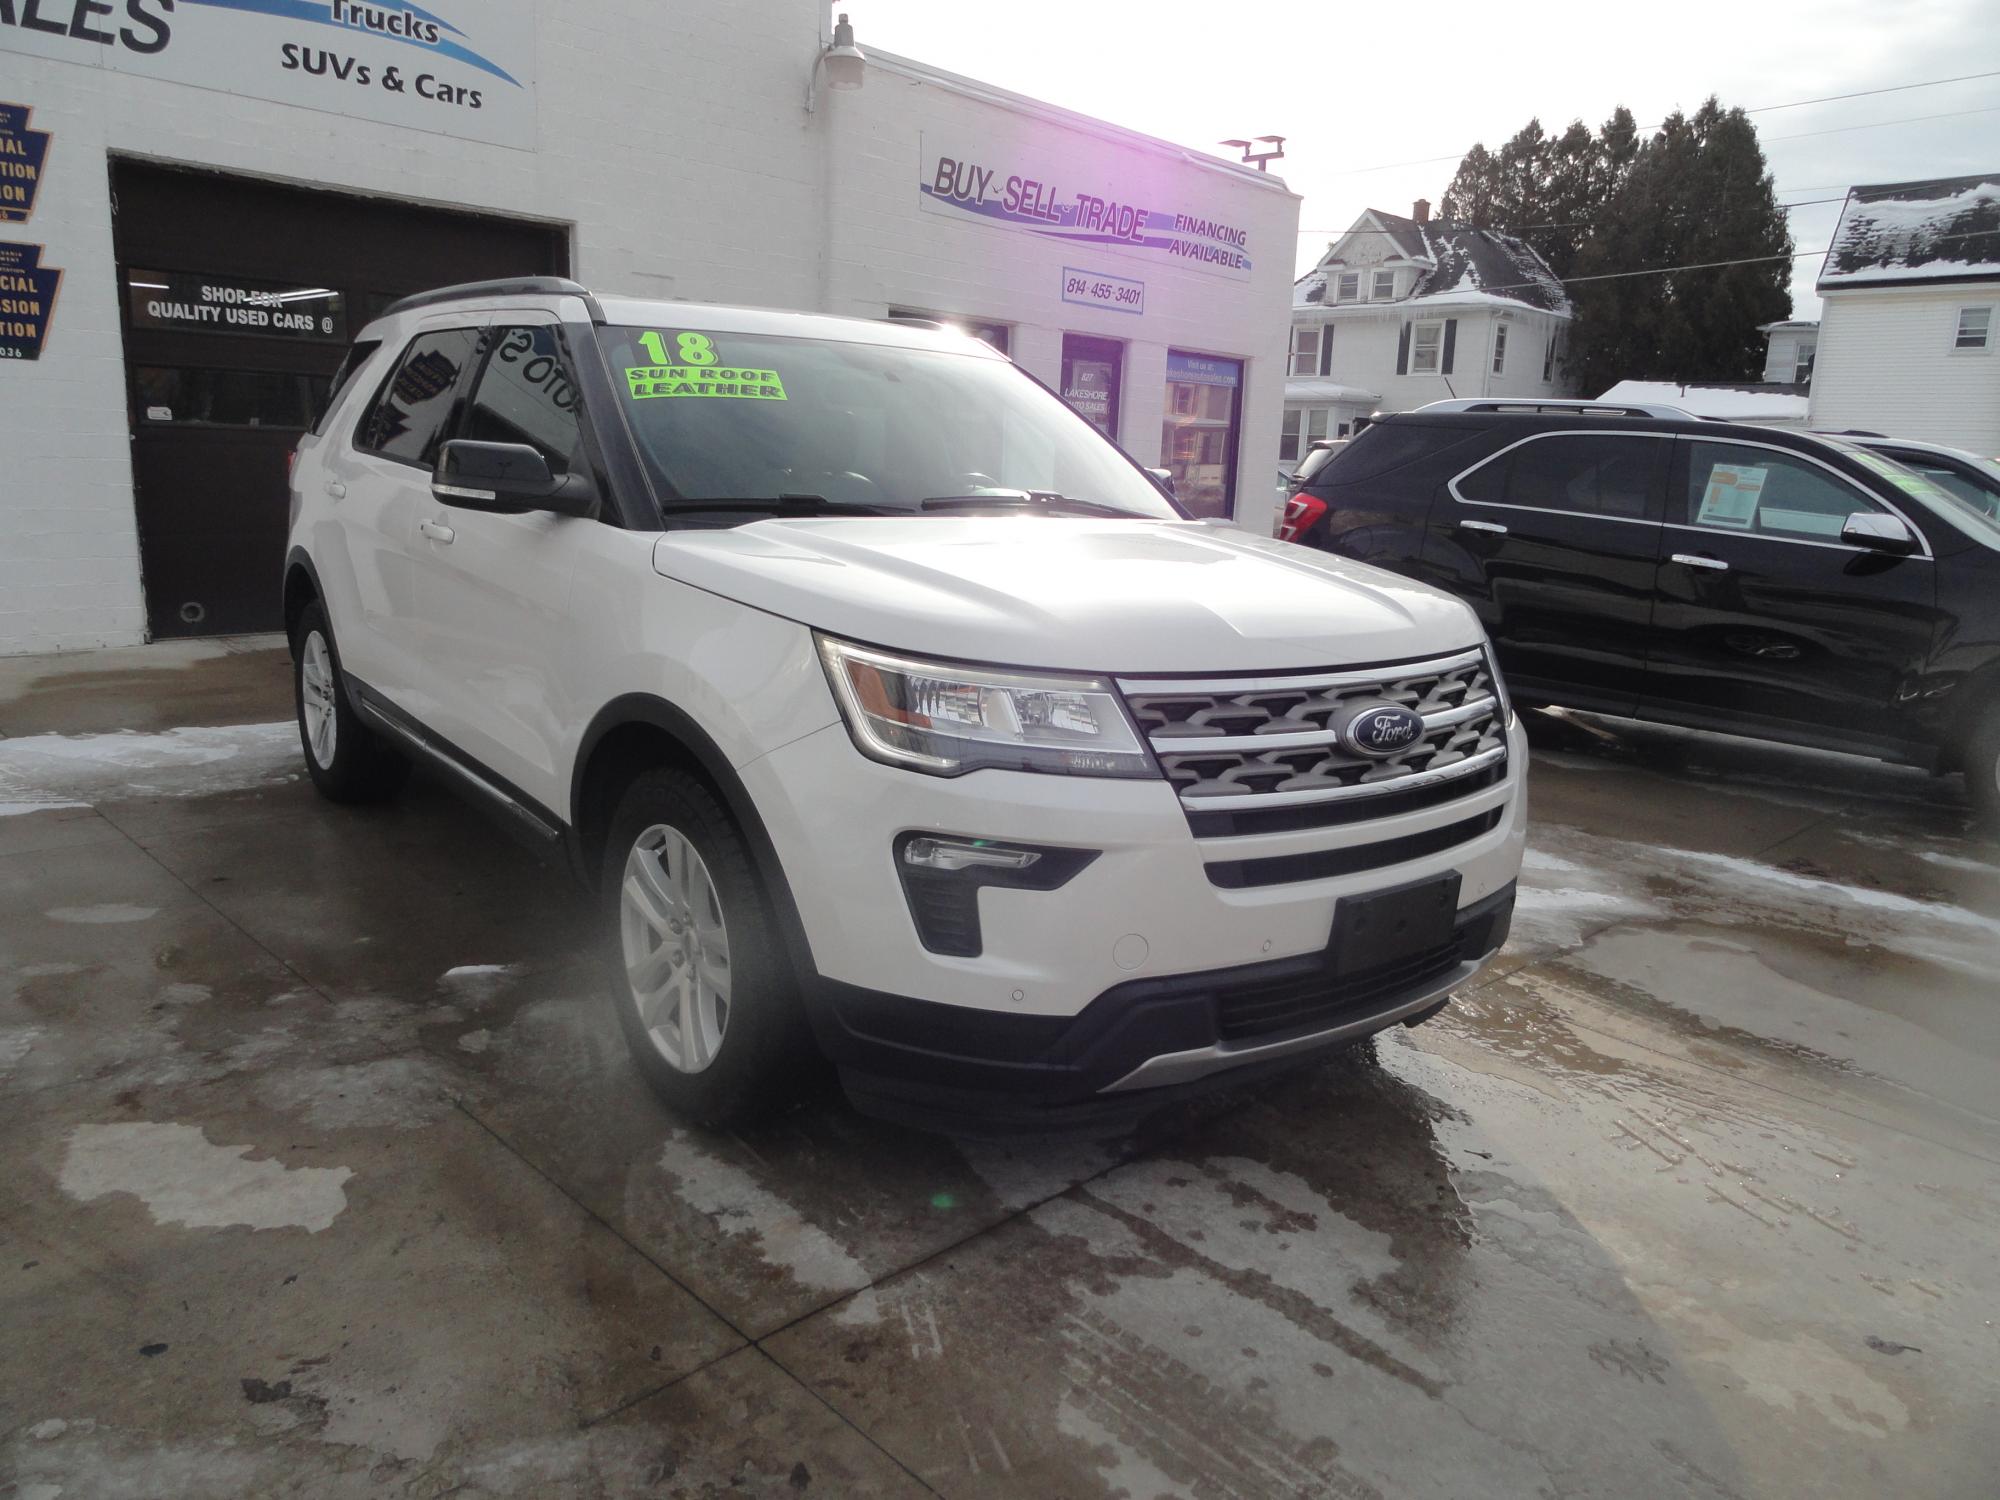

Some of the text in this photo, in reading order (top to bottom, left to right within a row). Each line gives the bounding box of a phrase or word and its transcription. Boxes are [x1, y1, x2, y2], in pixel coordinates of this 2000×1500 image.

[332, 0, 438, 42] Trucks
[281, 43, 482, 108] SUVs & Cars
[933, 156, 1149, 242] BUY SELL TRADE
[1174, 213, 1247, 246] FINANCING
[1168, 239, 1243, 269] AVAILABLE
[0, 298, 40, 315] SION
[202, 285, 246, 304] SHOP
[148, 301, 334, 333] QUALITY USED CARS @
[638, 331, 718, 365] 18
[630, 368, 775, 382] SUN ROOF
[634, 382, 781, 398] LEATHER
[1064, 387, 1109, 401] LAKESHORE
[1372, 714, 1413, 744] Ford
